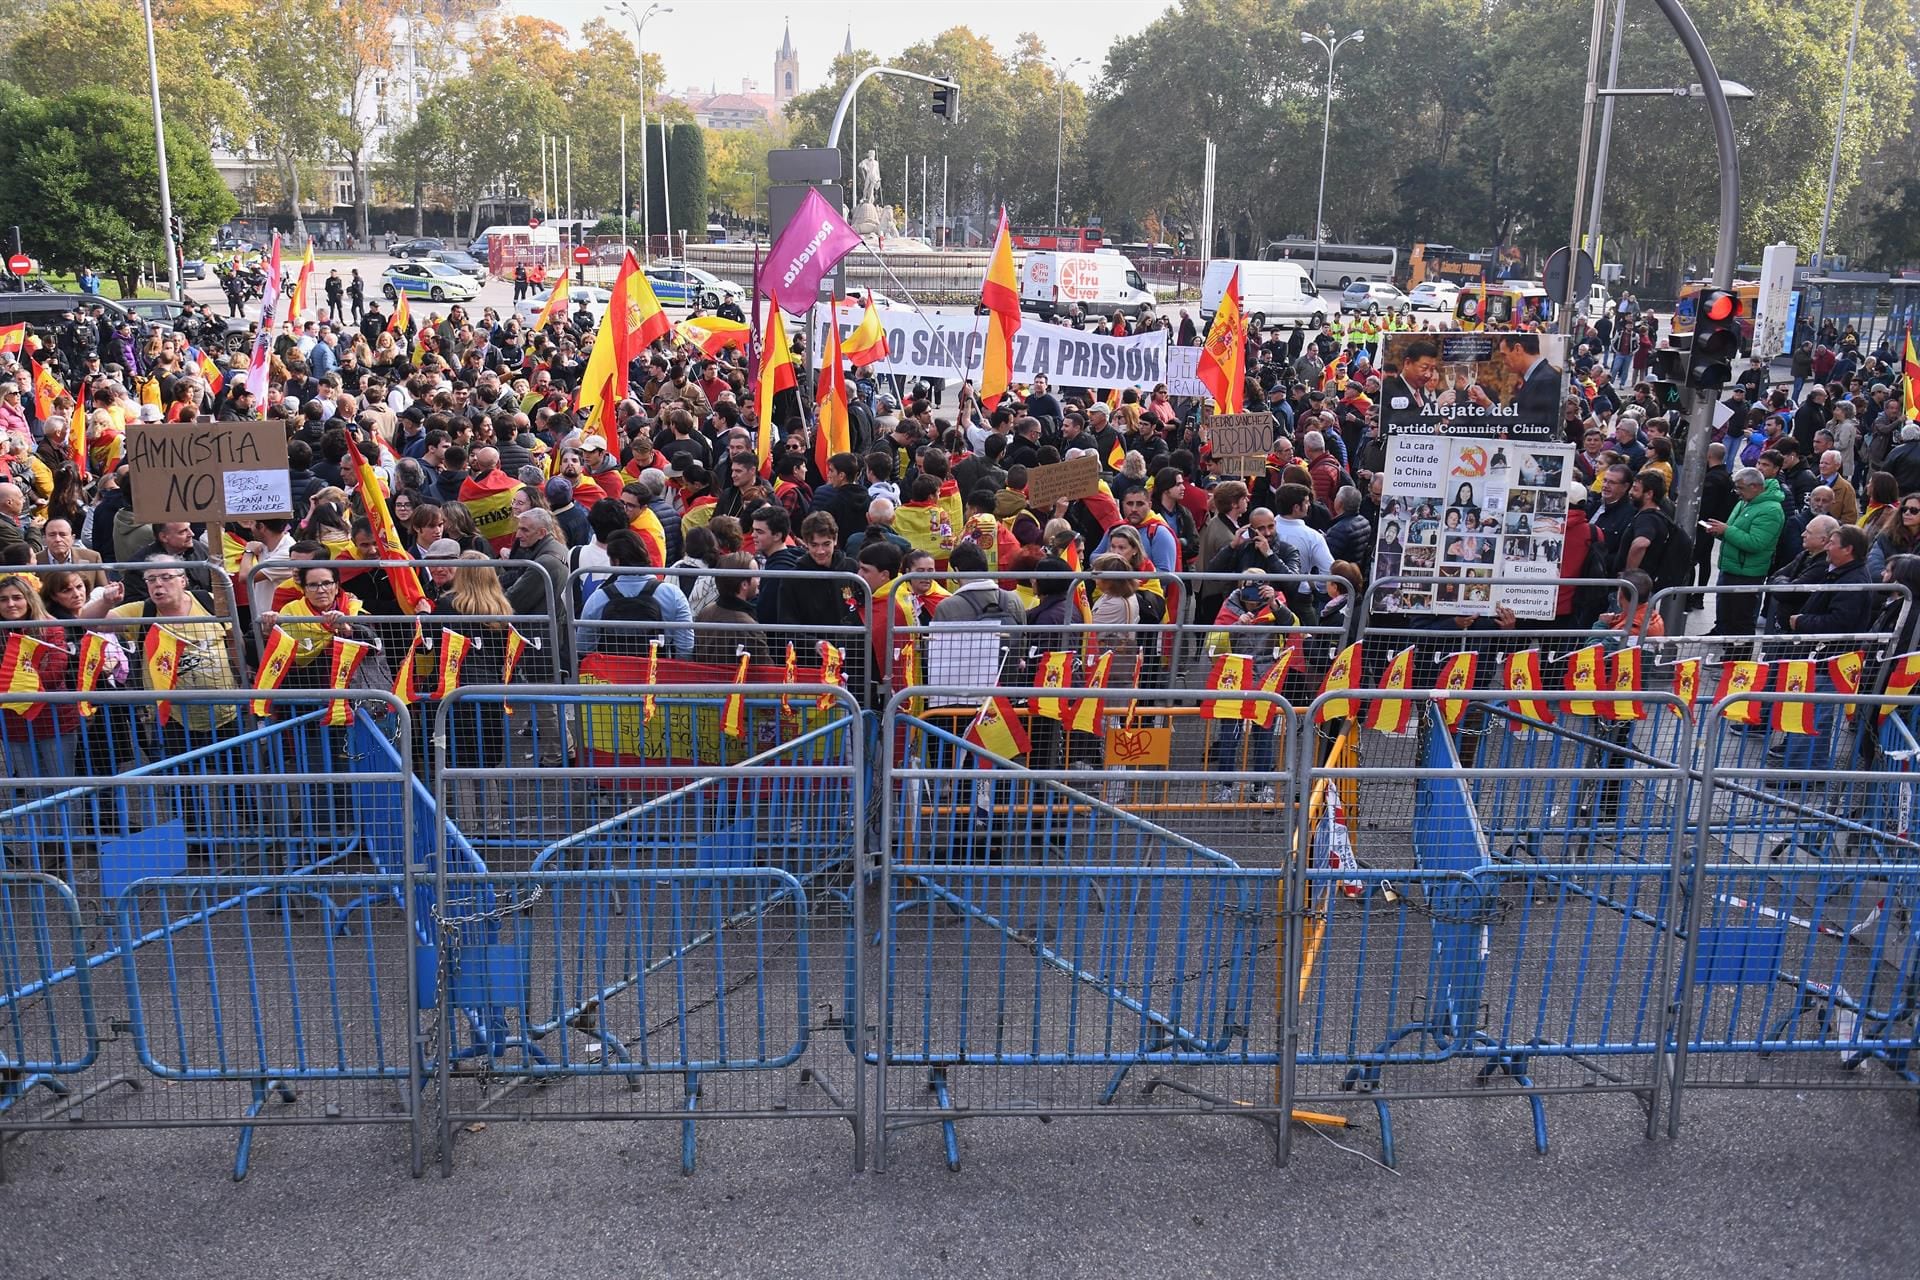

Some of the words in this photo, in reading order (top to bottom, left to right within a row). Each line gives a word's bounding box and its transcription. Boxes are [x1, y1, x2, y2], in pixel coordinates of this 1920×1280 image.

[1079, 258, 1097, 271] Dis
[1079, 274, 1099, 286] fru
[1079, 289, 1099, 300] ver
[1032, 337, 1050, 374] A
[1056, 339, 1160, 382] PRISIÓN
[1420, 402, 1489, 420] Aléjate
[1492, 402, 1519, 417] del
[1210, 416, 1234, 427] PEDRO
[1388, 423, 1435, 434] Partido
[1439, 423, 1509, 434] Comunista
[1512, 423, 1550, 434] Chino
[1400, 441, 1411, 449] La
[1413, 443, 1434, 451] cara
[1395, 454, 1425, 463] oculta
[1427, 455, 1439, 464] de
[1394, 467, 1403, 476] la
[1405, 467, 1432, 477] China
[1392, 480, 1437, 489] comunista
[165, 473, 215, 512] NO
[267, 494, 281, 502] NO
[251, 502, 285, 512] QUIERE
[1514, 565, 1522, 573] El
[1505, 587, 1550, 595] comunismo
[1512, 597, 1542, 606] destruir
[1514, 609, 1551, 617] umanidad
